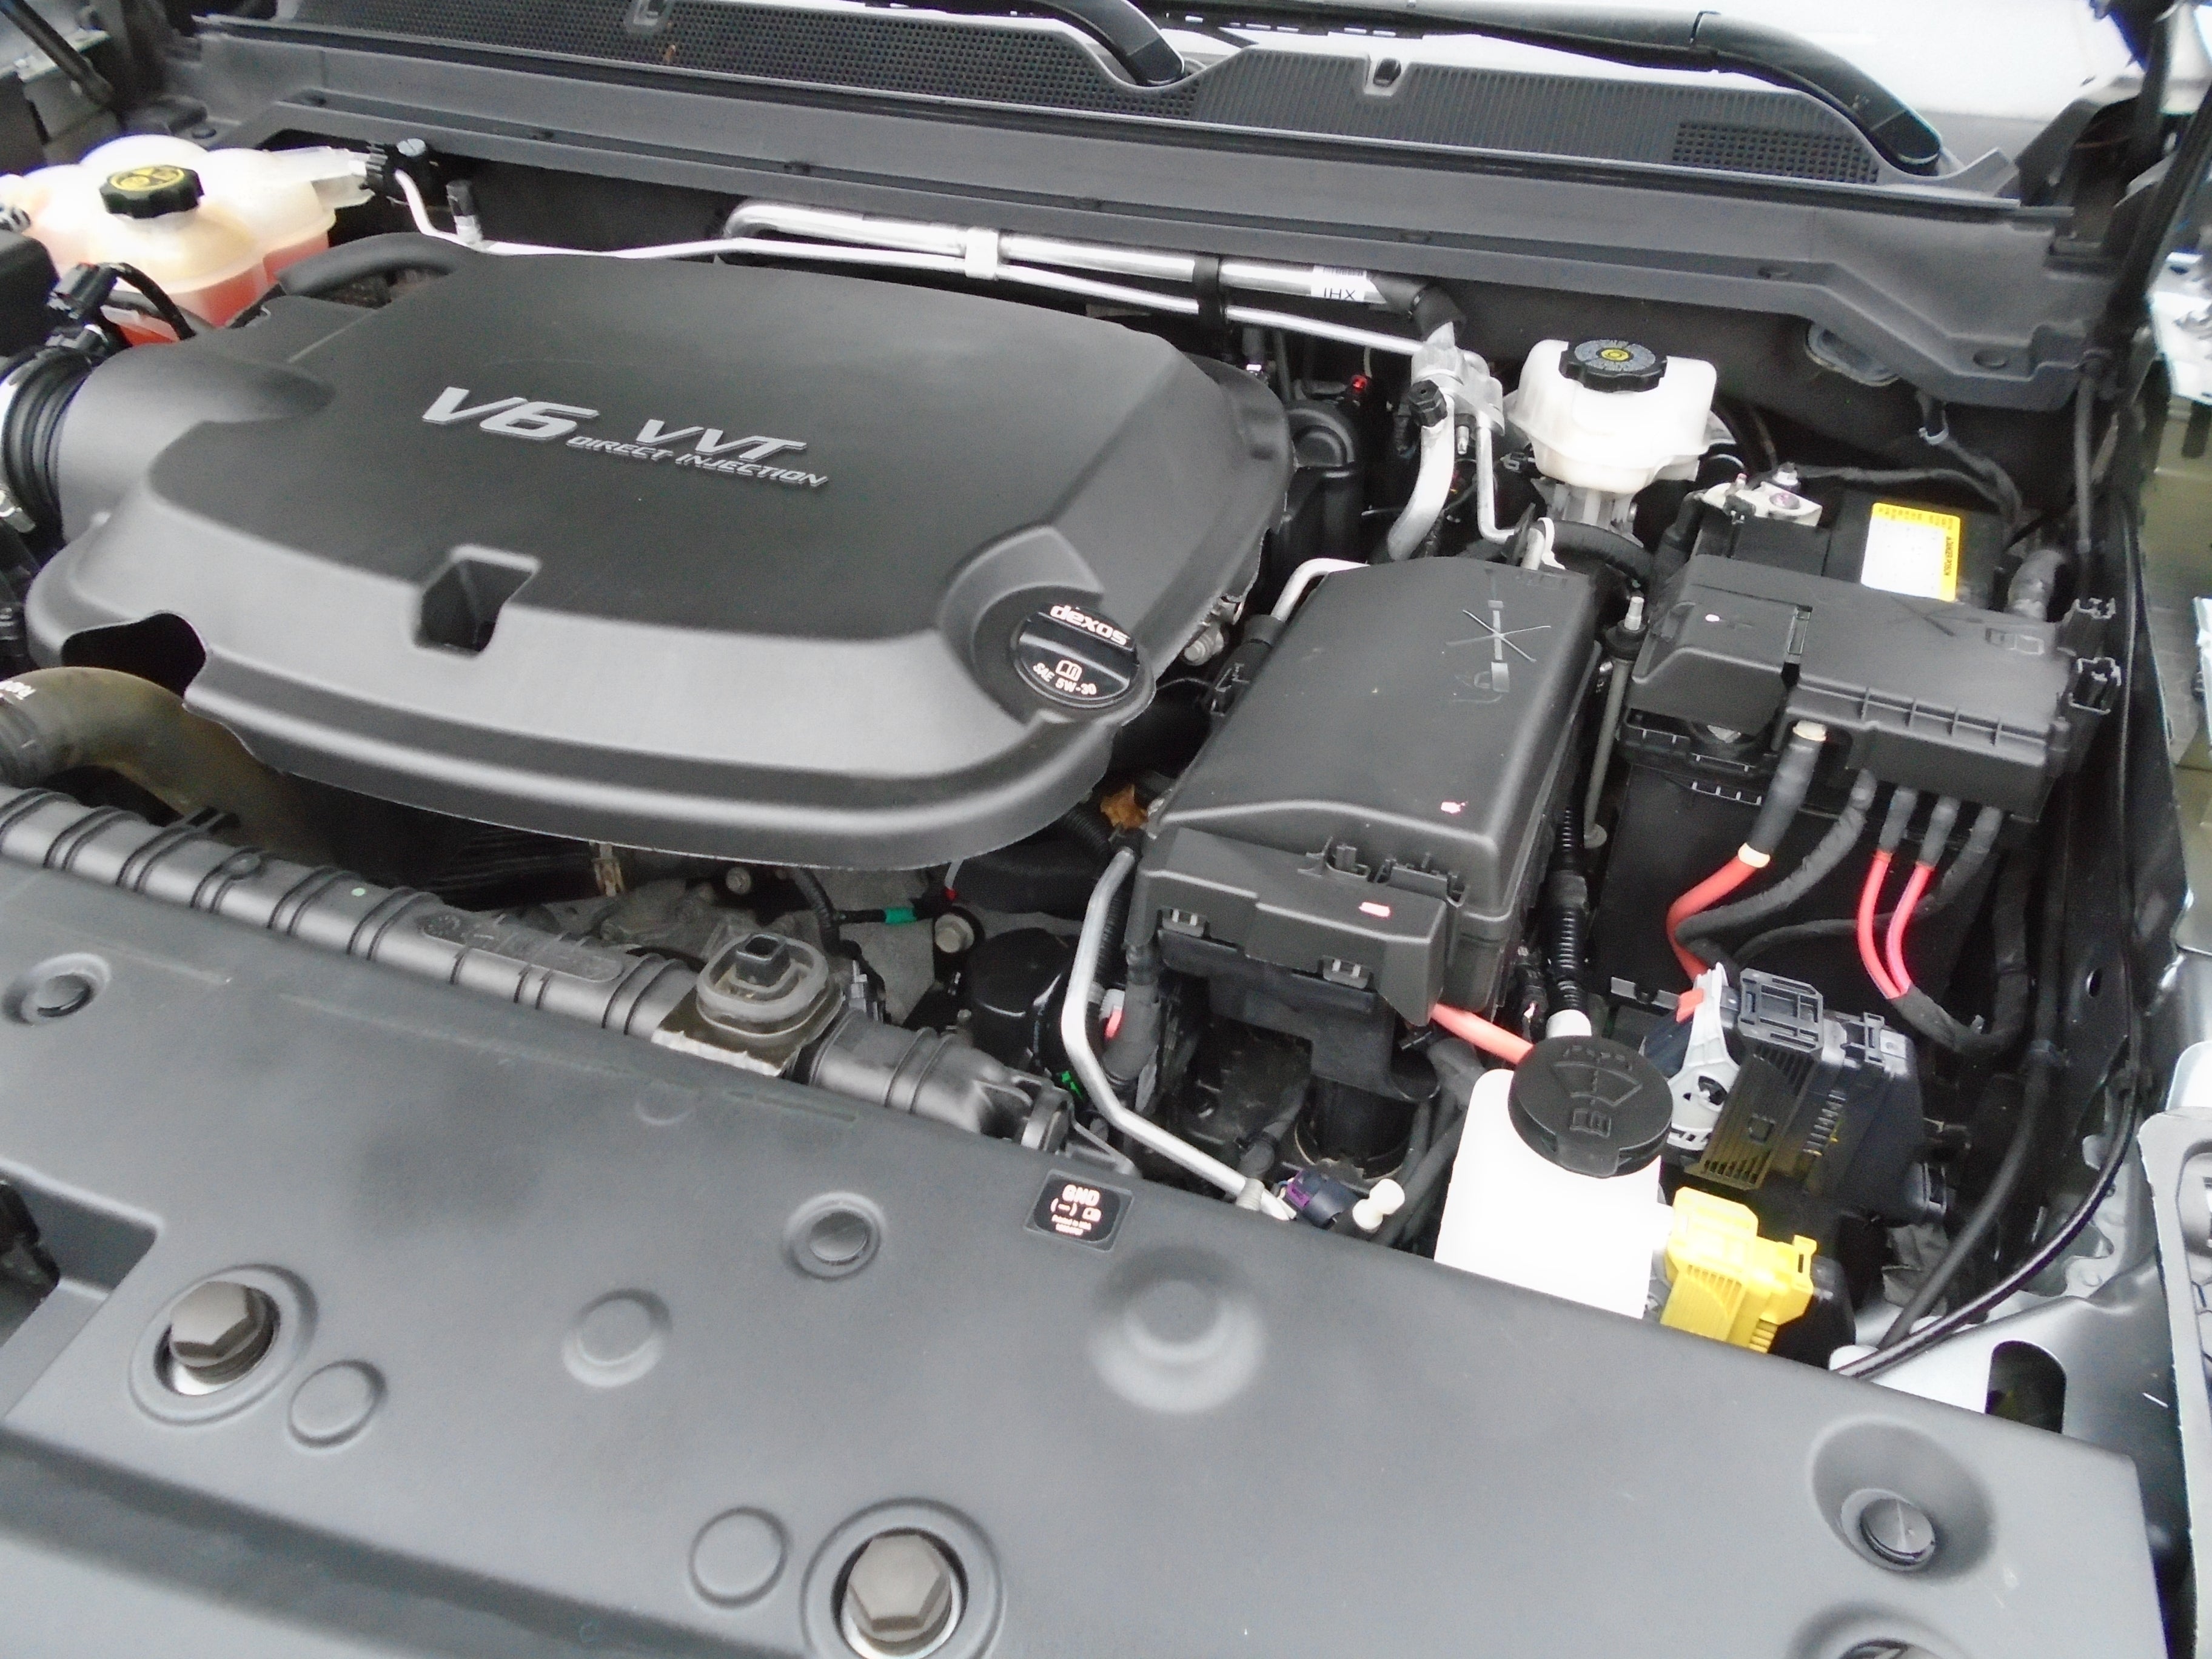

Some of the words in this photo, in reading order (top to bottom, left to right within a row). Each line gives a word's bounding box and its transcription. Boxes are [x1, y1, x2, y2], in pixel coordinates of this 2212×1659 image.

[423, 386, 600, 440] V6
[635, 418, 807, 462] VVT
[566, 435, 674, 460] DIRECT
[674, 453, 828, 487] INJECTION
[1050, 605, 1130, 646] dexos
[1033, 663, 1055, 683] SAE
[1056, 679, 1097, 695] 5W-30
[1062, 1184, 1100, 1207] GND
